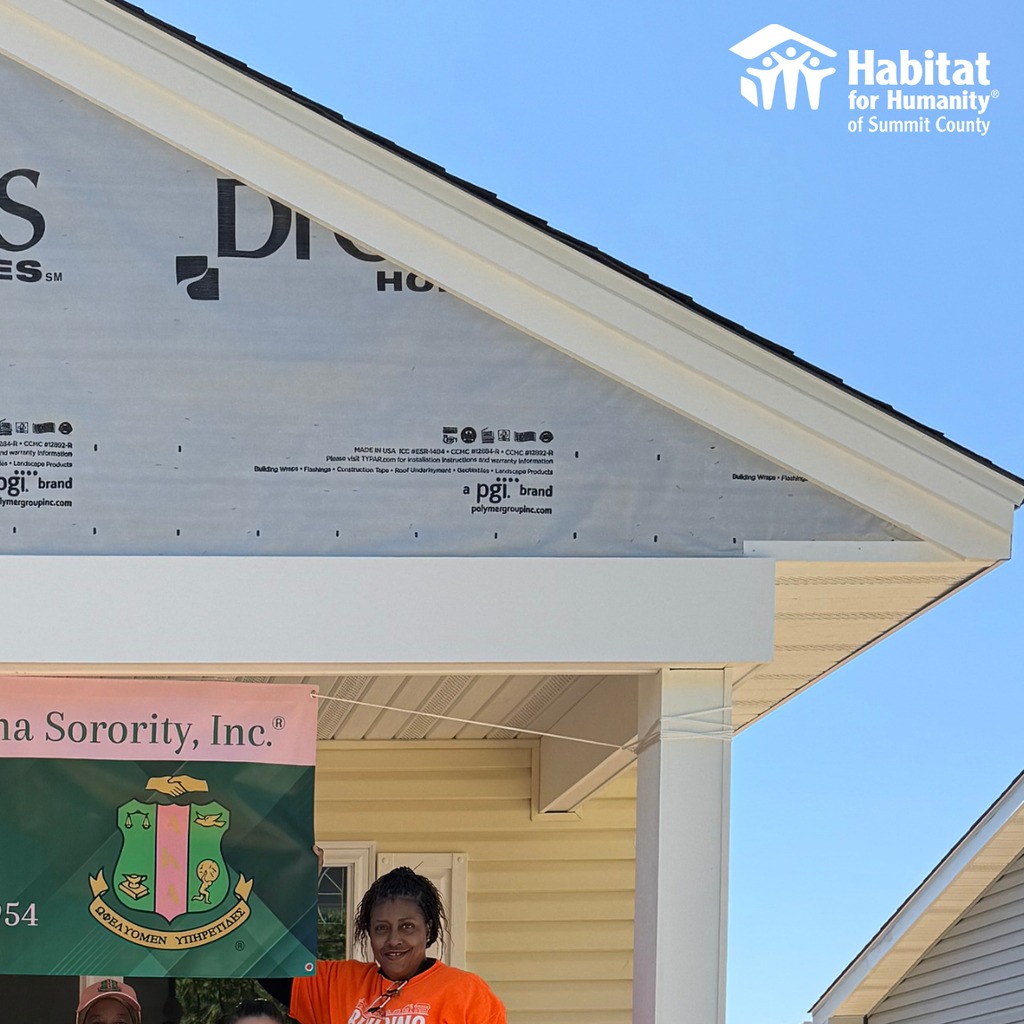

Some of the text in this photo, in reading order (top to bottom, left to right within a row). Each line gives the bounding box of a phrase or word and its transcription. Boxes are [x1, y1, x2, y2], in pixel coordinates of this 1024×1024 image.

[38, 477, 73, 489] brand
[463, 485, 470, 495] a
[519, 484, 553, 497] brand
[471, 504, 553, 515] polymergroupinc.com
[45, 710, 200, 755] Sorority,
